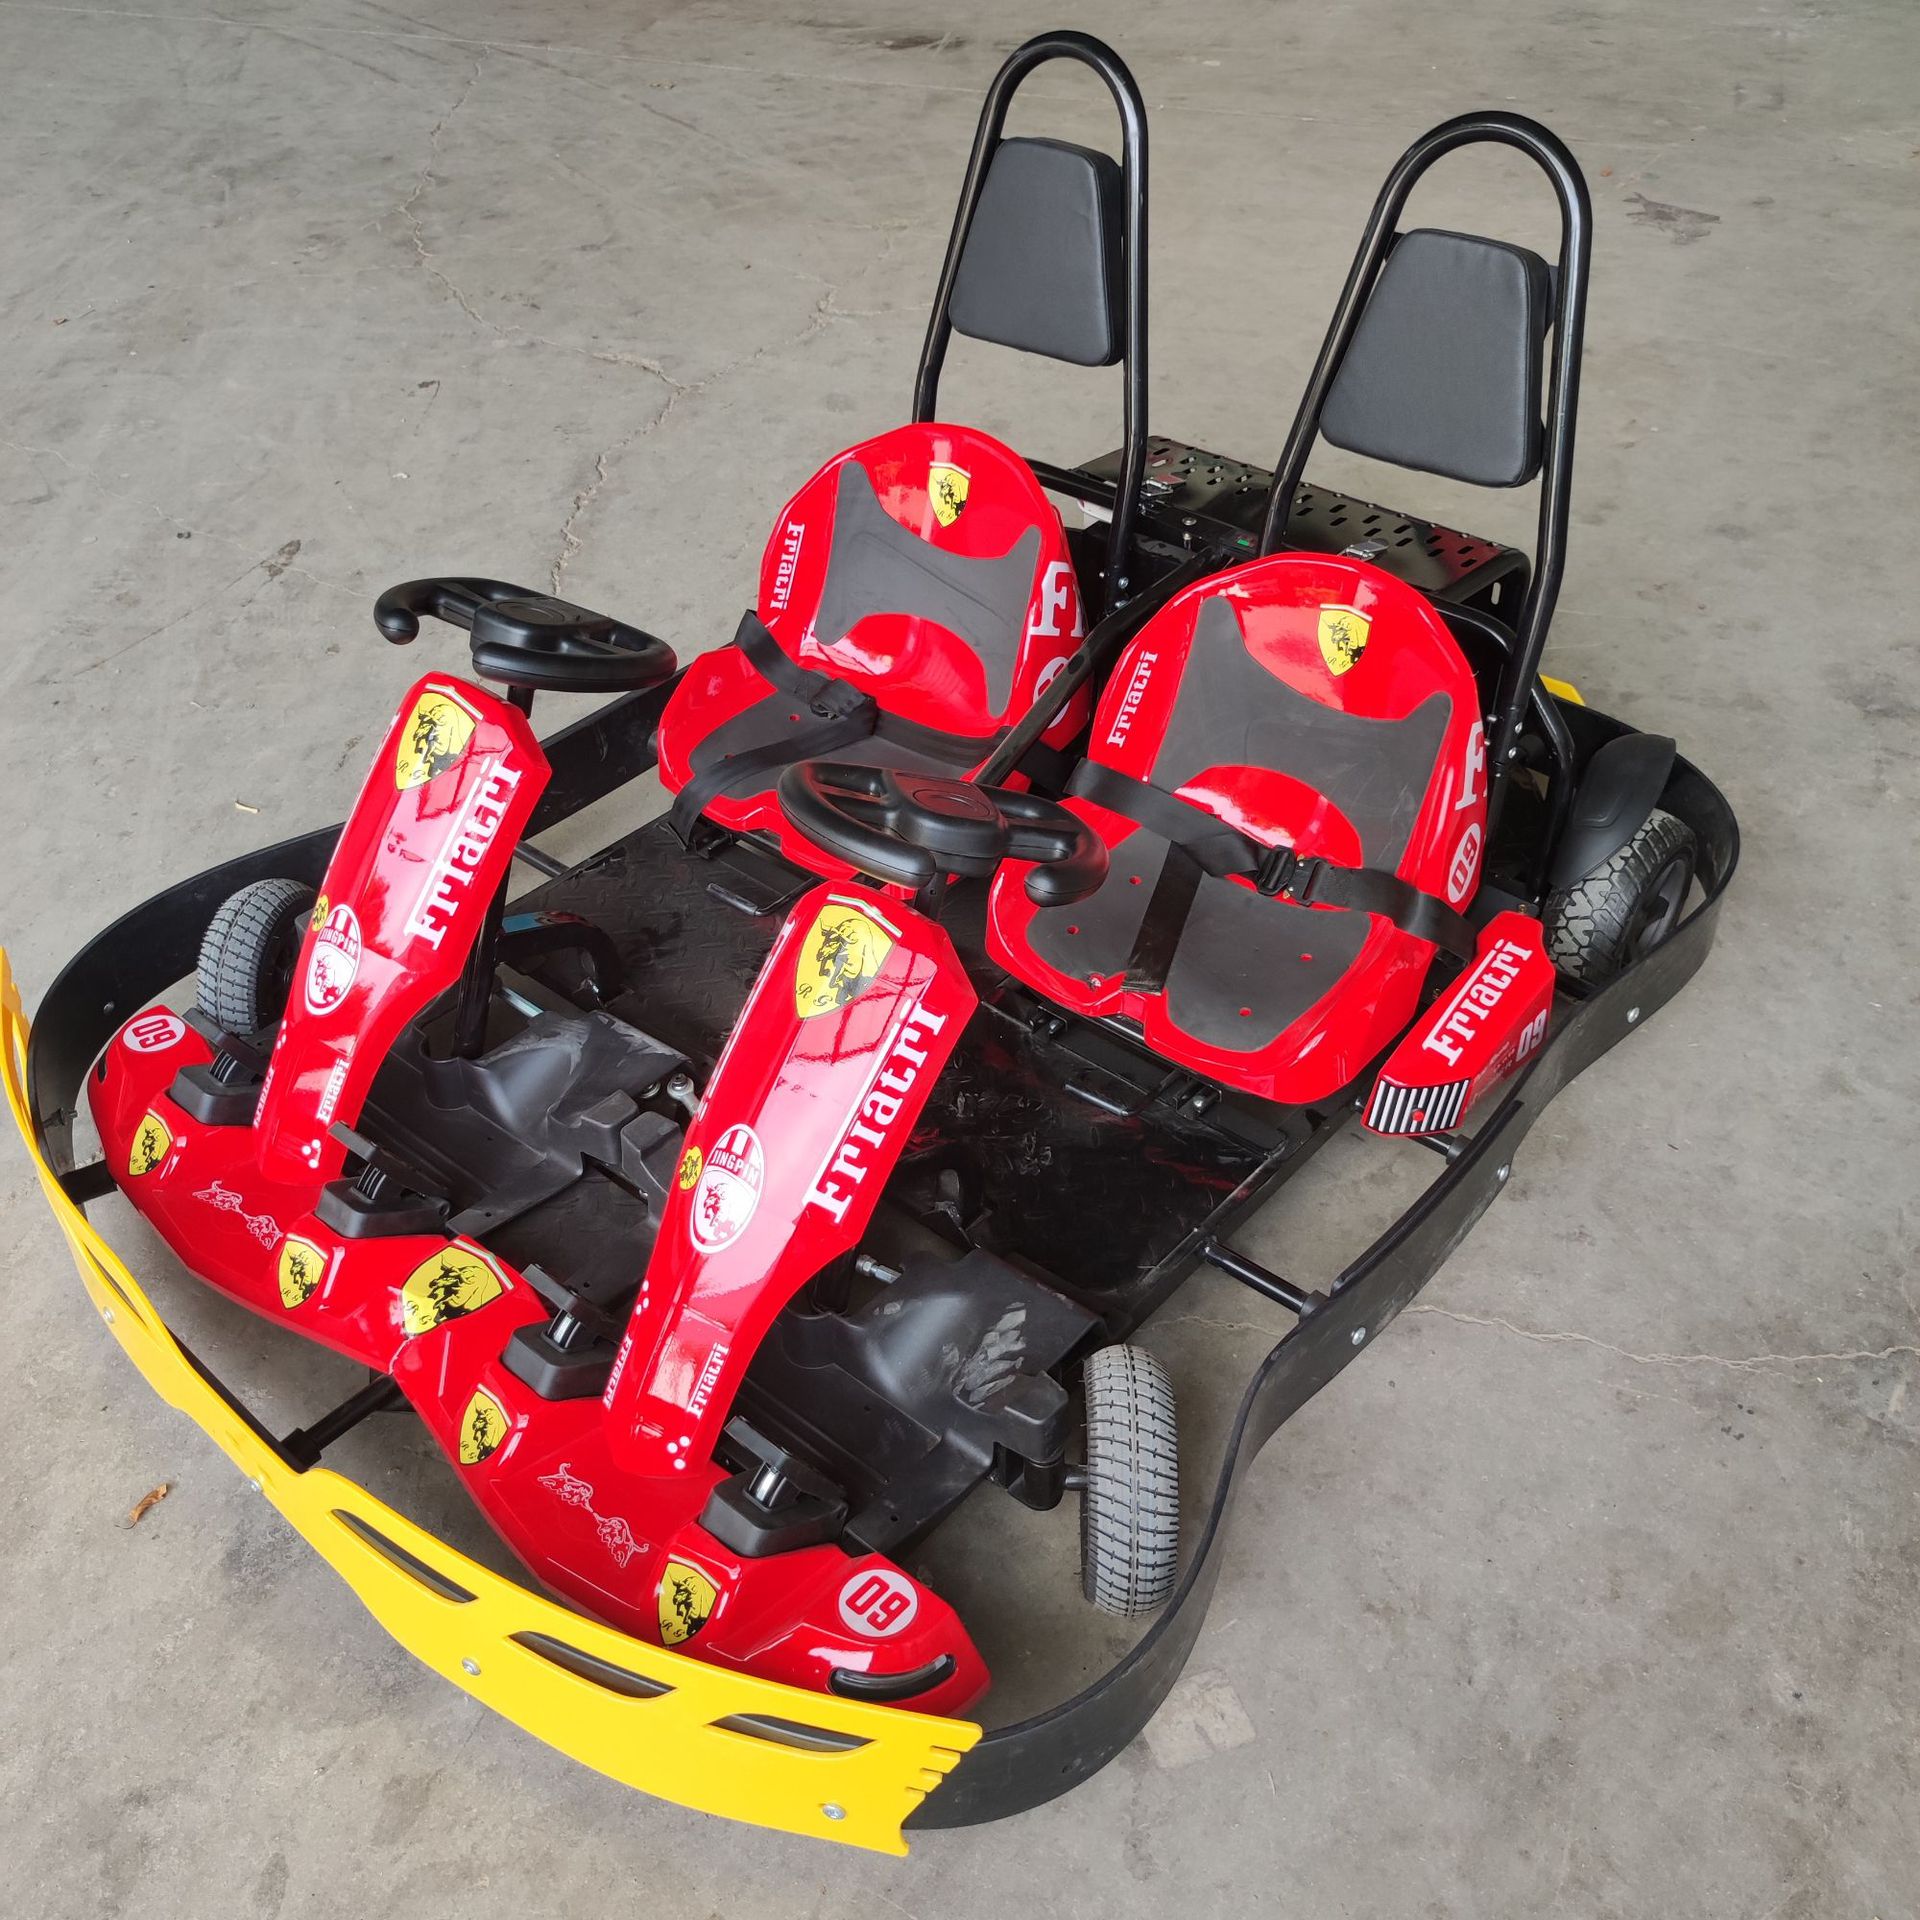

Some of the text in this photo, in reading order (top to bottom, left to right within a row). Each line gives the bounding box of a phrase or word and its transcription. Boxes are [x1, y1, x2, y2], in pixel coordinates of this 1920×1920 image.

[1451, 832, 1477, 895] 09
[132, 1018, 177, 1049] 09
[1515, 1008, 1547, 1062] 09
[845, 1575, 911, 1631] 09
